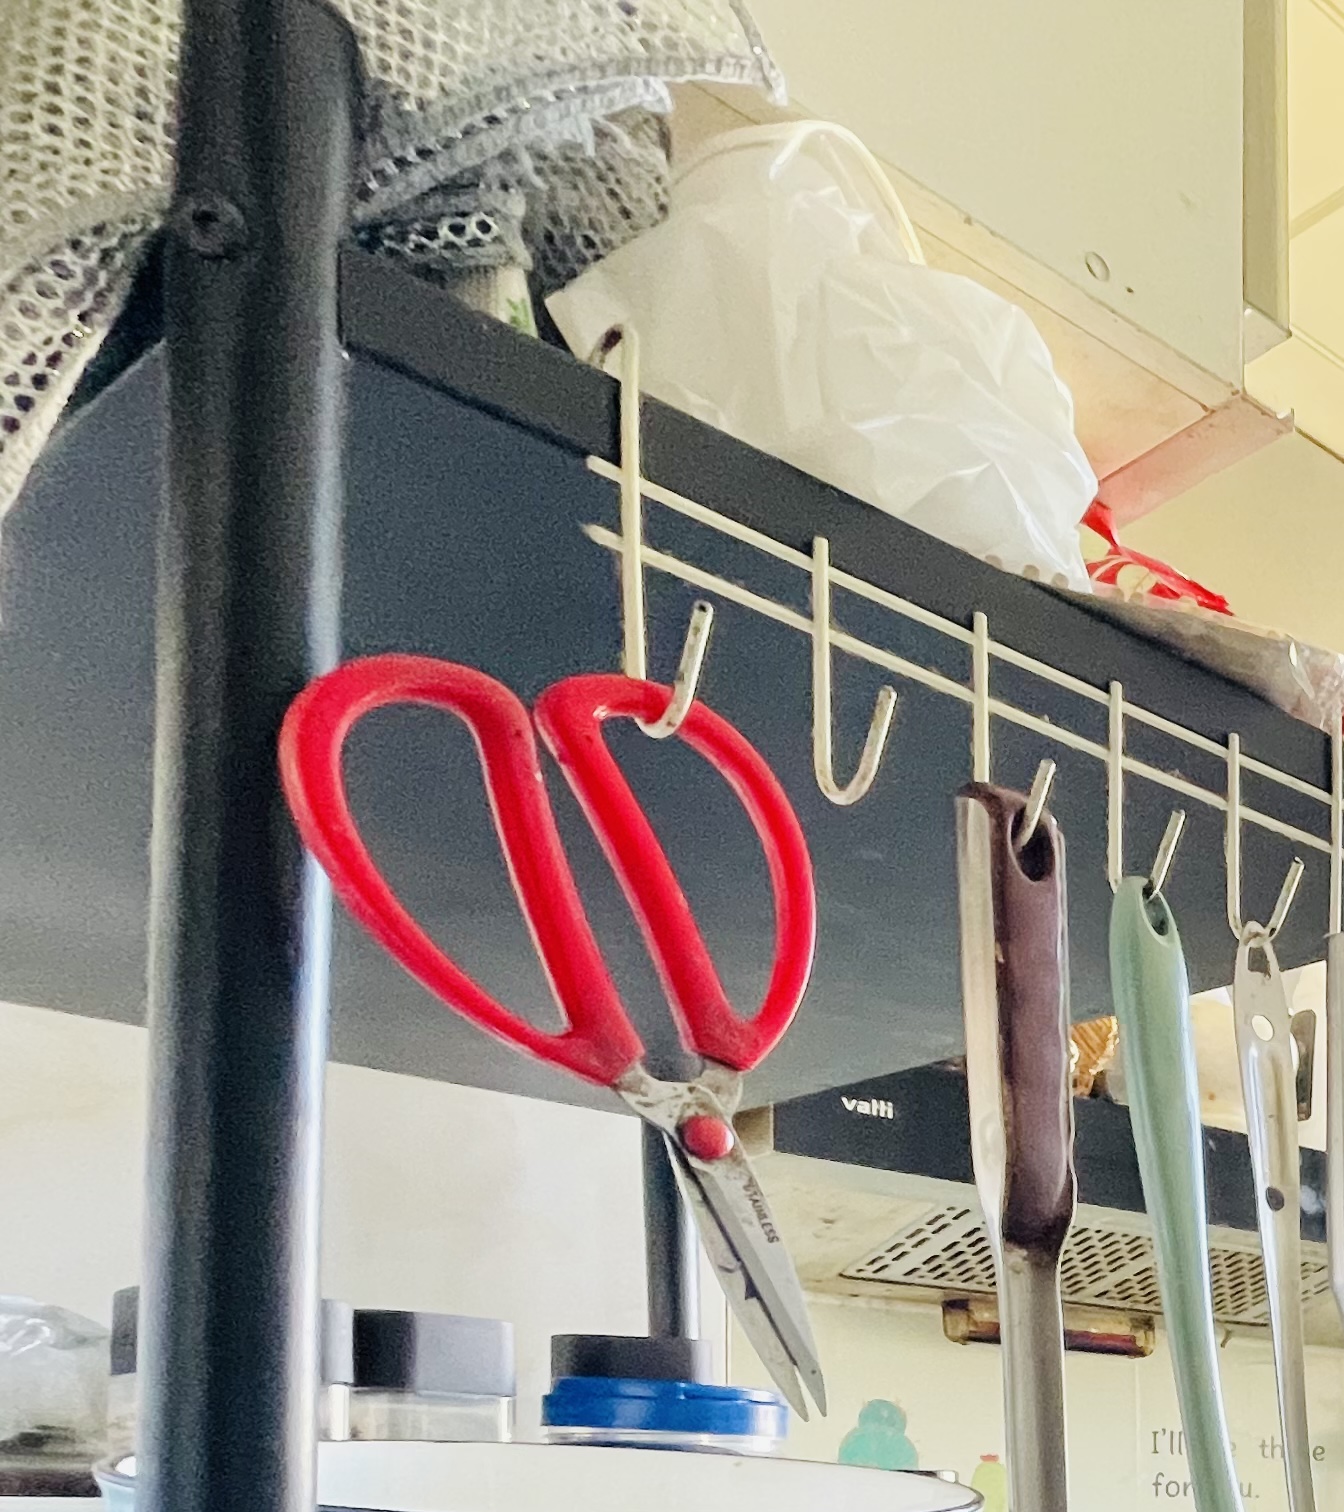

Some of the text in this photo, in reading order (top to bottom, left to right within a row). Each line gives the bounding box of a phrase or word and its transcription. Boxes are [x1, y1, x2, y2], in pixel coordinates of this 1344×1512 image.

[1151, 1428, 1184, 1456] I'll
[1258, 1436, 1325, 1462] the
[1152, 1472, 1193, 1498] for
